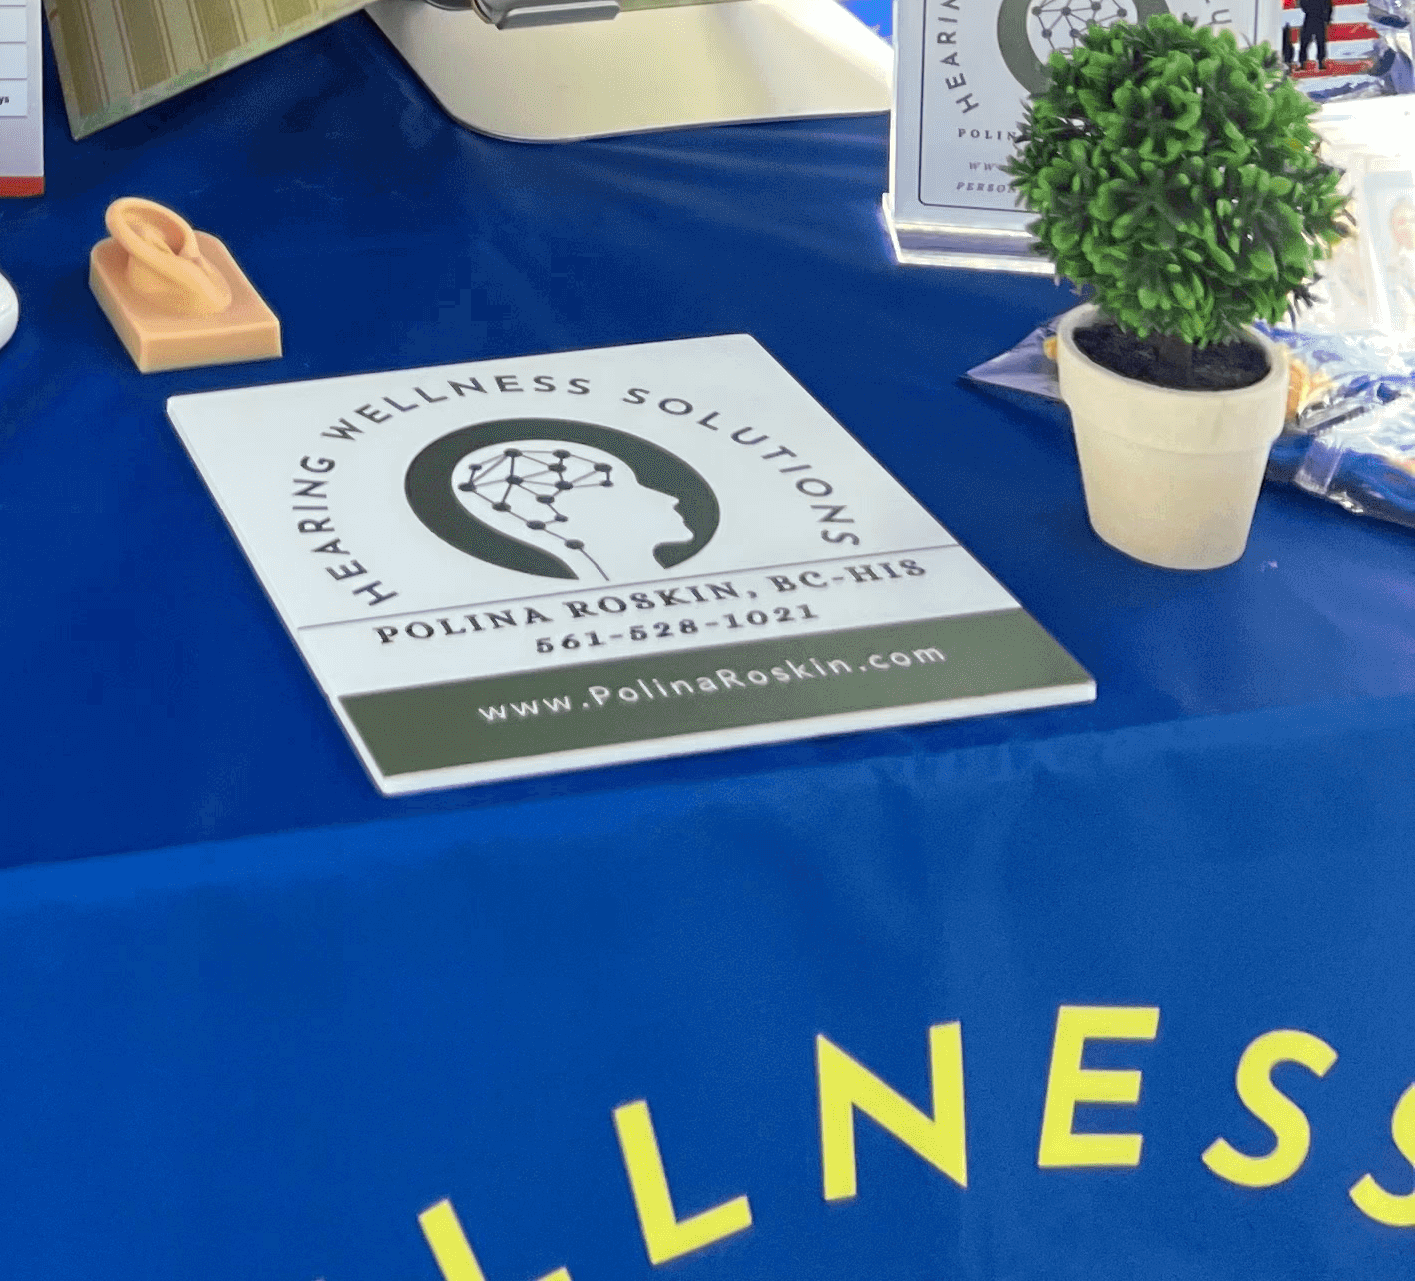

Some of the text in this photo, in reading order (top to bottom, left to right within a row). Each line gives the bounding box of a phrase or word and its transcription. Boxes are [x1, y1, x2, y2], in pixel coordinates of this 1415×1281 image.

[291, 373, 862, 608] HEARING WELLNESS SOLUTIONS
[376, 557, 927, 646] POLINA ROSKIN, BC-HIS
[535, 601, 820, 656] 561-528-1021
[478, 642, 946, 727] www.PolinaRoskin.com
